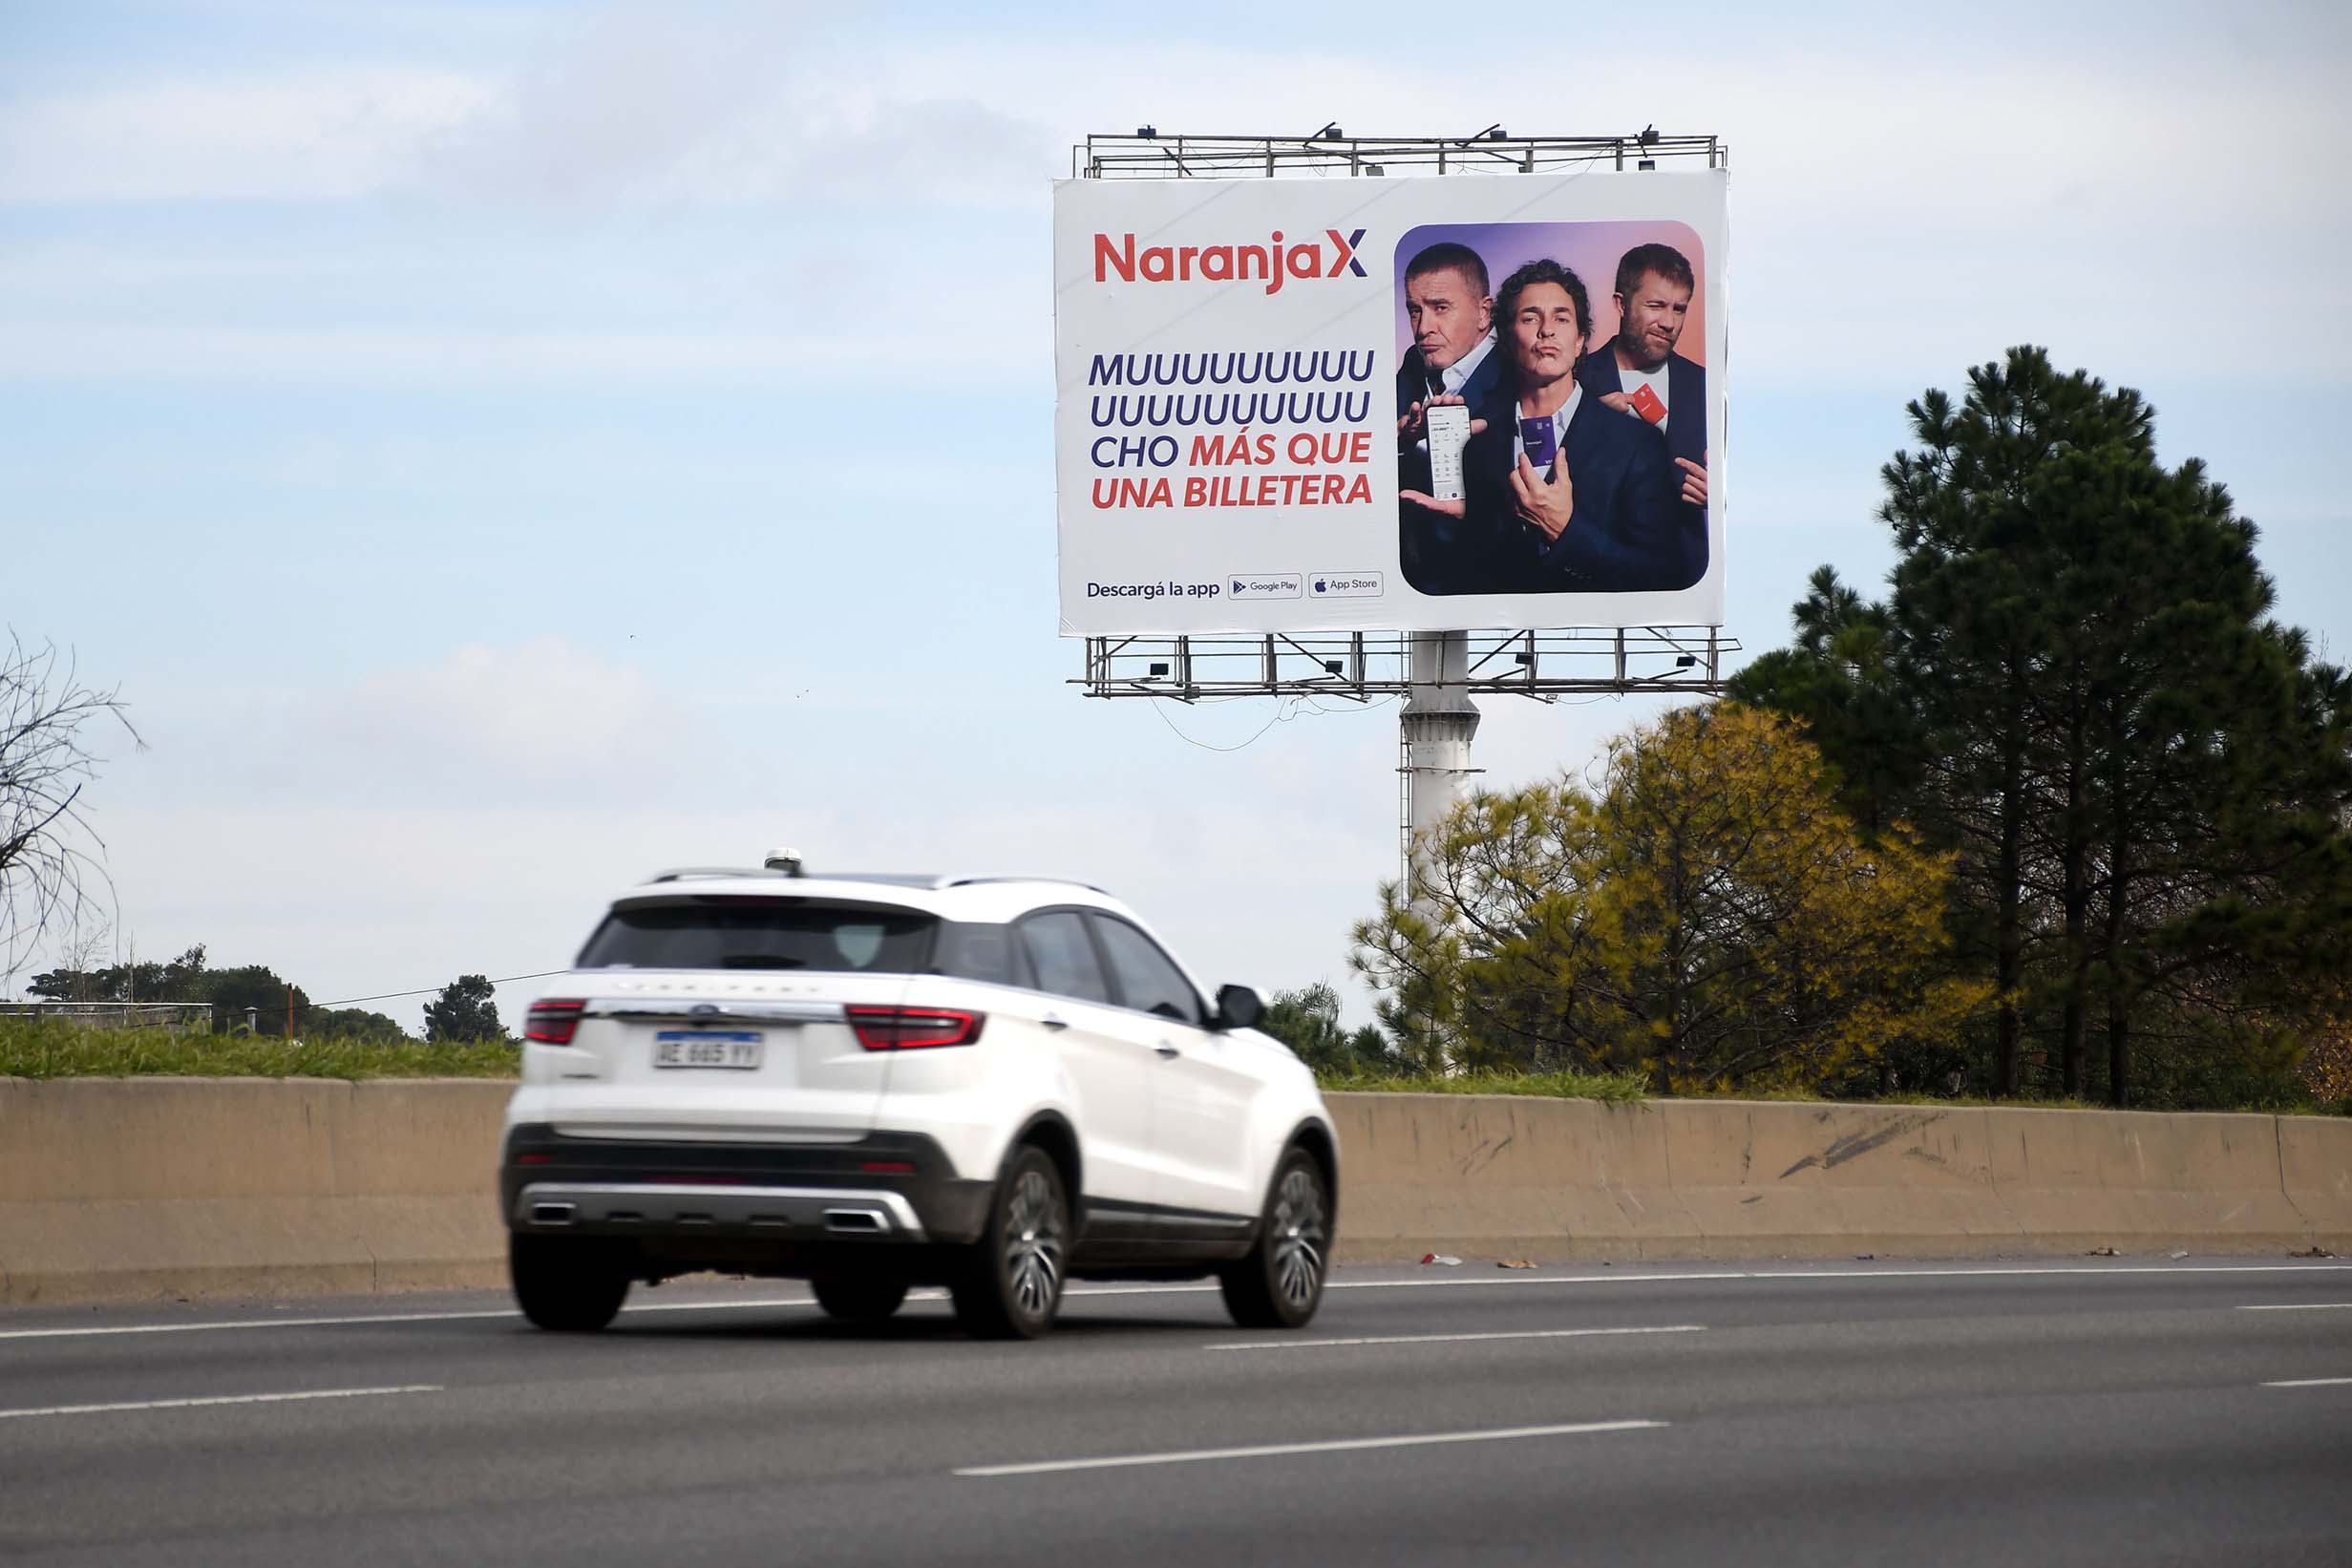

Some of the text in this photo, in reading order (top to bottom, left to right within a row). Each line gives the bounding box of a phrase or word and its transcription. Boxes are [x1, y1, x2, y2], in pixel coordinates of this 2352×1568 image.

[1088, 350, 1375, 387] MUUUUUUUUU
[1091, 391, 1371, 428] UUUUUUUUUU
[1091, 425, 1372, 468] CHO MÁS QUE
[1091, 473, 1373, 510] UNA BILLETERA
[1087, 581, 1220, 601] Descargá la app
[1249, 580, 1298, 593] Google Play
[1329, 579, 1378, 592] App Store
